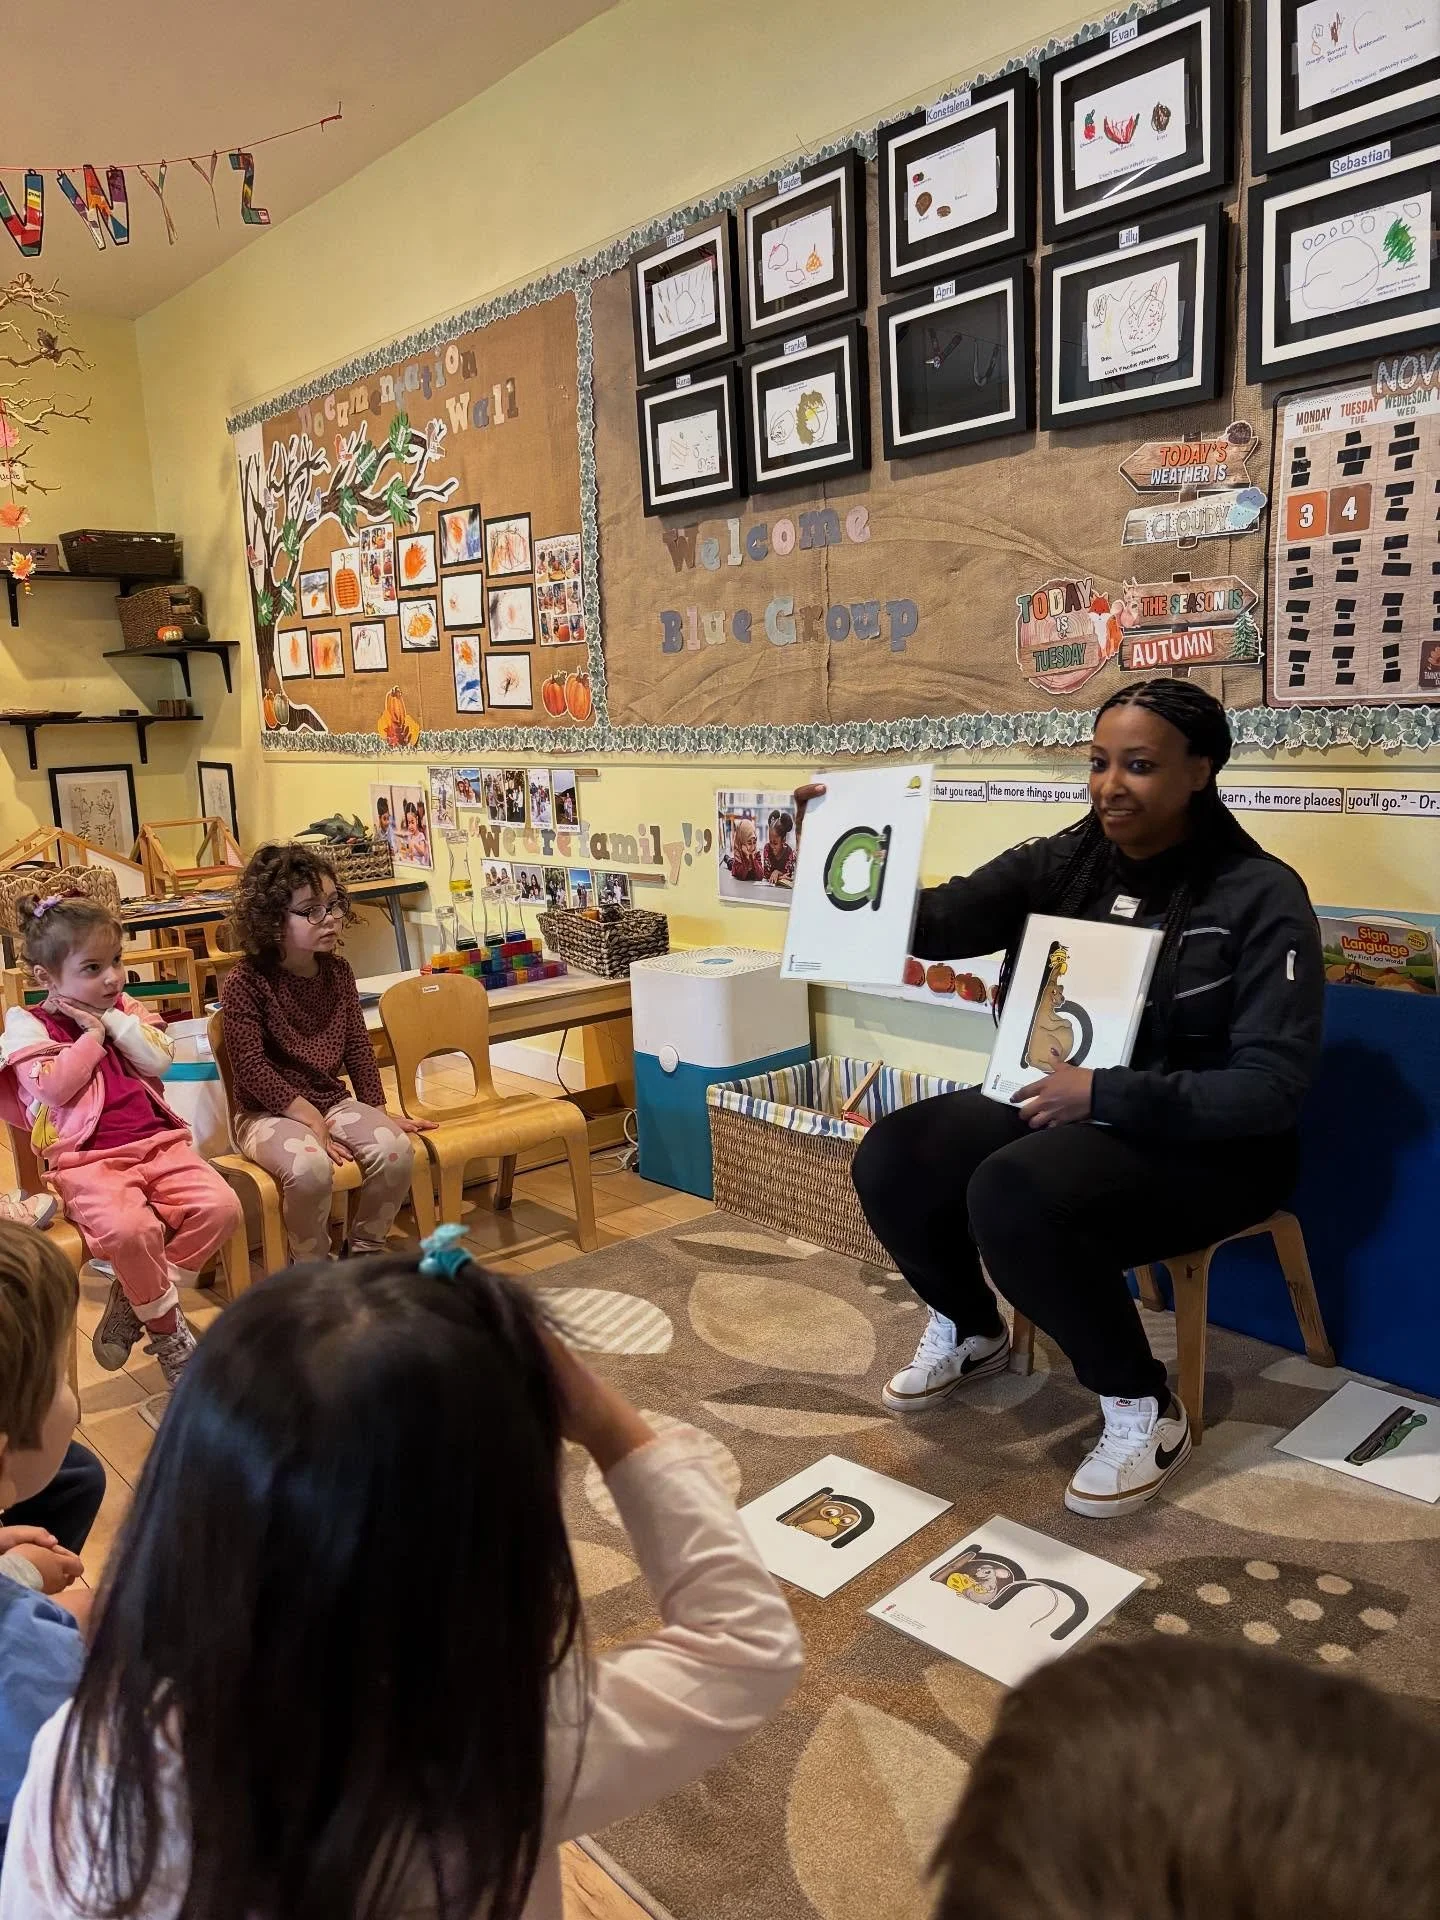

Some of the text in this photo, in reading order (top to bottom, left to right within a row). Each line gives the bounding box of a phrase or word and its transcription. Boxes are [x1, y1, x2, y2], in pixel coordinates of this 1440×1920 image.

[1111, 28, 1135, 44] Evan
[926, 98, 970, 122] Konstalena
[1332, 148, 1391, 175] Sebastian
[1120, 228, 1139, 245] Lilly
[936, 283, 954, 300] April
[446, 377, 518, 434] Wall
[1296, 389, 1432, 426] MONDAY TUESDAY WEDNESDAY
[1302, 406, 1419, 434] MON. TUE. WED.
[1160, 442, 1228, 467] TODAY'S
[1150, 464, 1228, 486] WEATHER IS
[1151, 505, 1231, 540] CLOUDY
[1299, 496, 1358, 528] 3 4
[662, 505, 870, 573] Welcome
[1018, 578, 1092, 623] TODAY
[1140, 588, 1244, 617] THE SEASON IS
[660, 597, 918, 654] Blue Group
[1056, 616, 1069, 632] IS
[1033, 642, 1087, 673] TUESDAY
[1132, 632, 1213, 668] AUTUMN
[950, 788, 963, 799] you
[964, 785, 985, 800] read,
[990, 785, 1087, 802] the more things you will
[1254, 790, 1271, 804] the
[1273, 794, 1301, 805] more
[1304, 792, 1341, 809] places
[1342, 936, 1409, 959] Language
[1359, 927, 1389, 943] Sign
